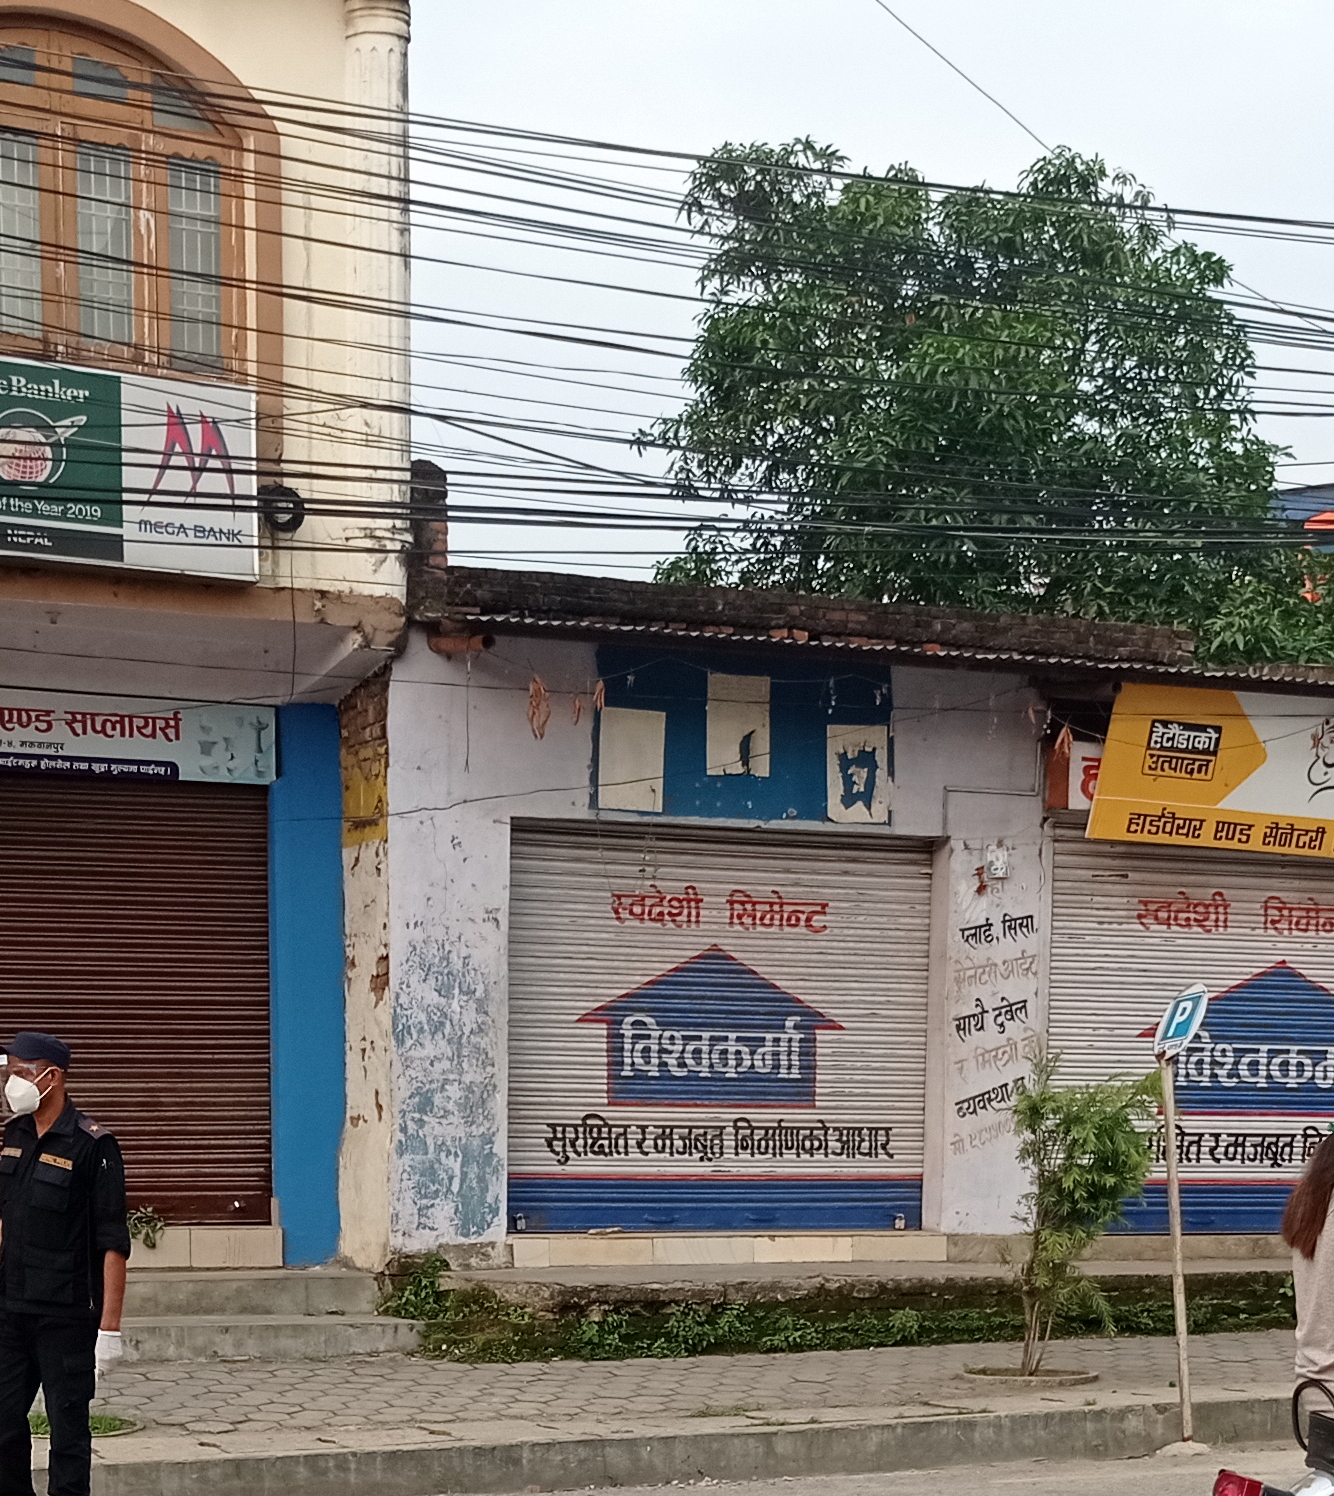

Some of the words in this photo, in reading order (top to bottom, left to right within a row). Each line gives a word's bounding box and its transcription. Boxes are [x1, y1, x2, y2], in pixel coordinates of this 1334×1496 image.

[8, 375, 90, 403] Banker
[36, 500, 64, 517] Year
[66, 502, 101, 521] 2019
[193, 524, 243, 543] BANK
[64, 710, 183, 743] सप्लायर्स
[1147, 752, 1213, 777] उत्पादन
[611, 885, 704, 928] स्वदेशी
[1136, 891, 1232, 933] स्वदेशी
[953, 997, 989, 1043] साथै
[1167, 1000, 1193, 1038] P
[619, 1013, 802, 1080] विश्वकर्मा
[954, 1082, 1012, 1118] व्यवस्था
[544, 1114, 629, 1166] सुरक्षित
